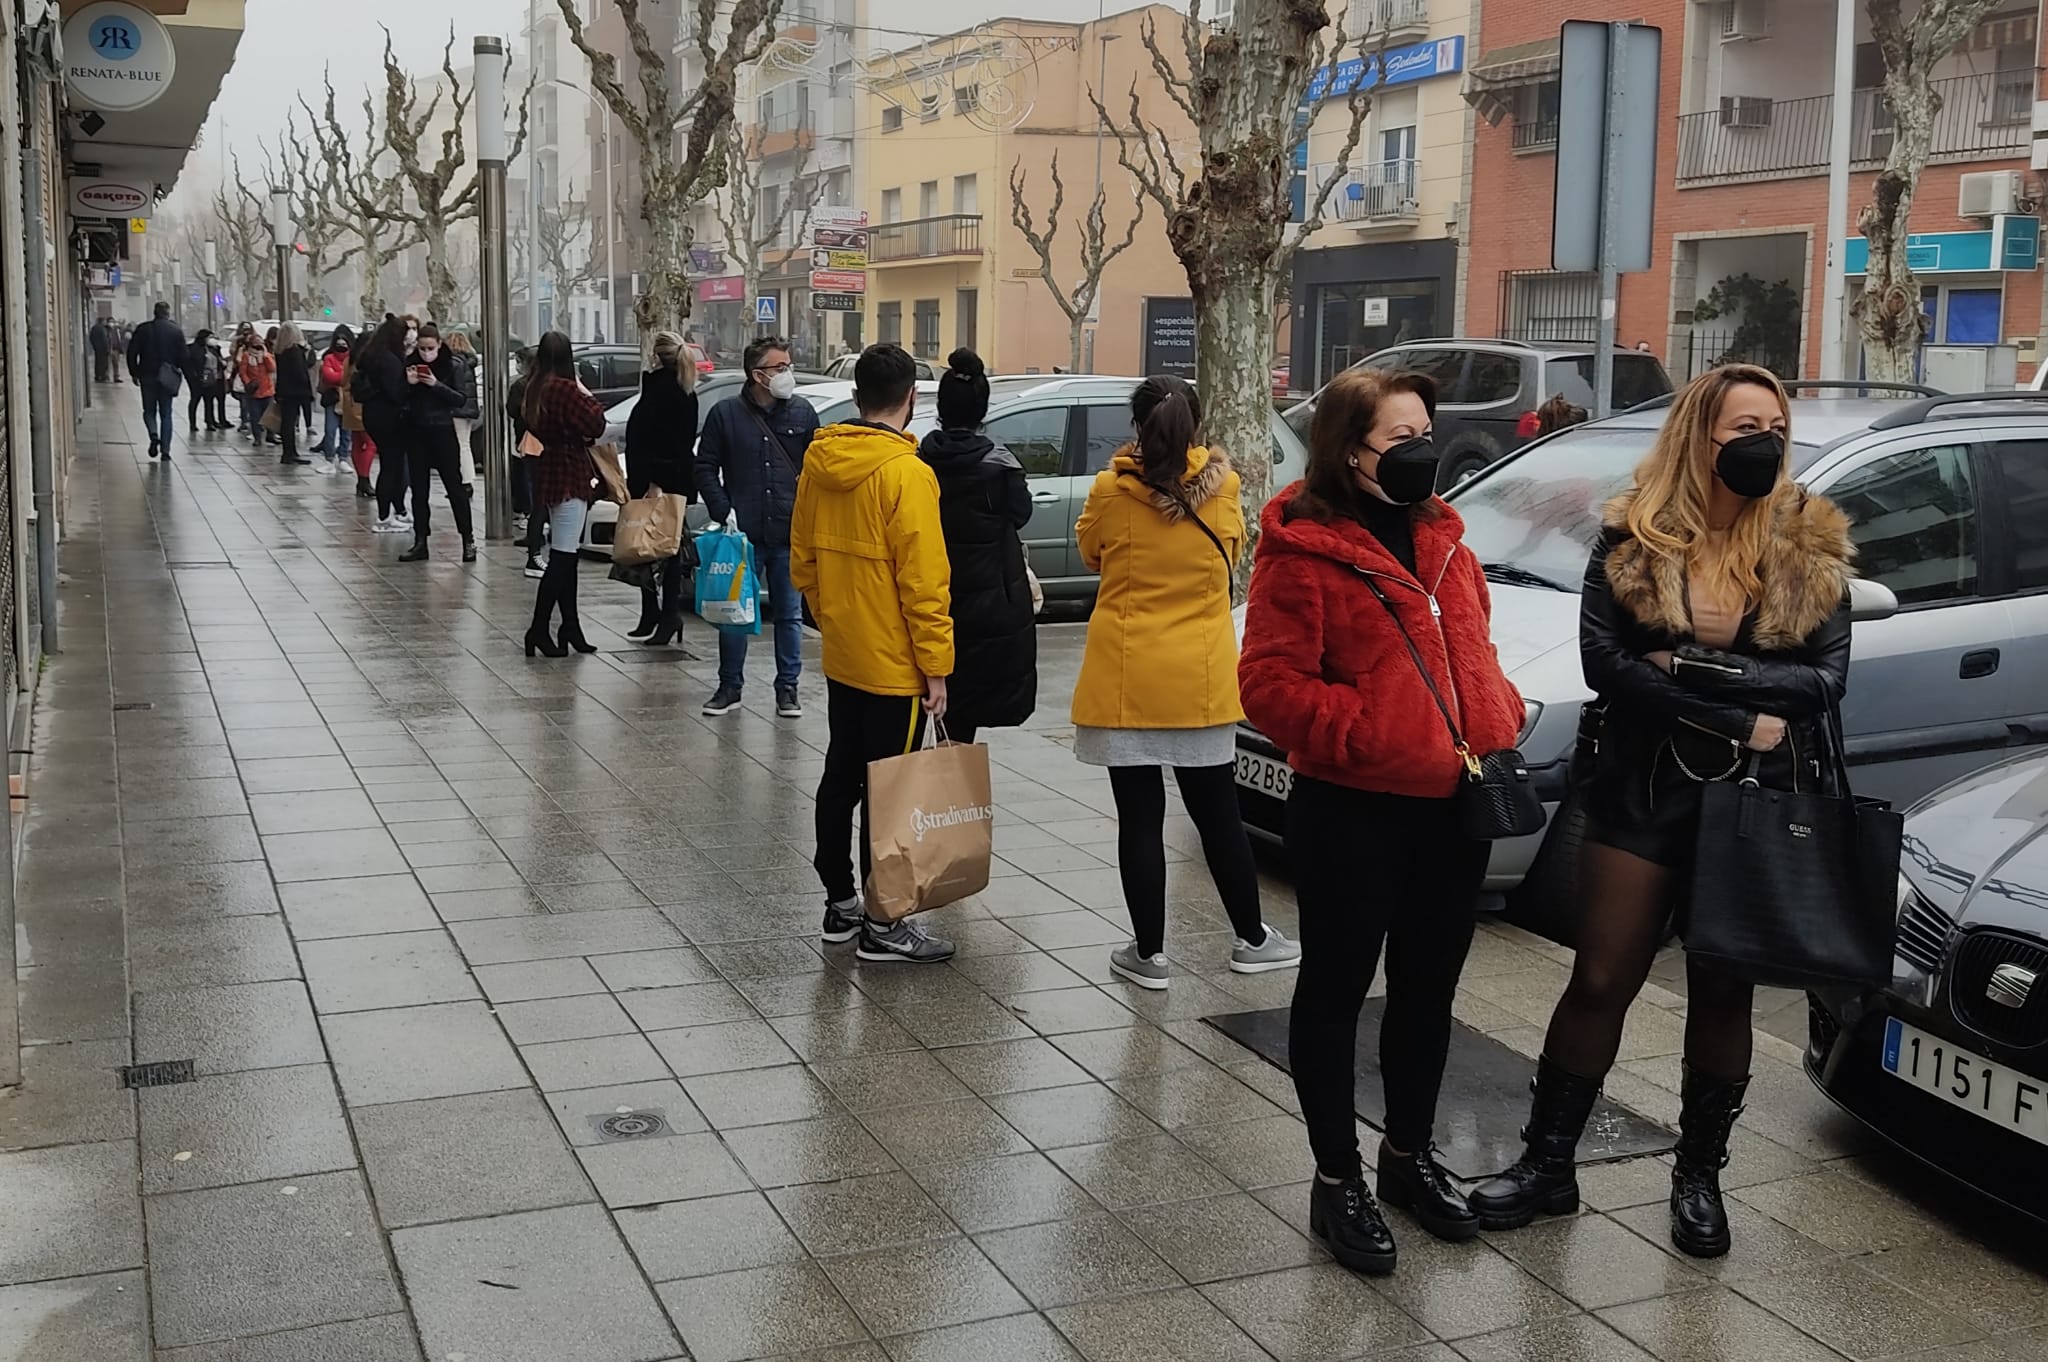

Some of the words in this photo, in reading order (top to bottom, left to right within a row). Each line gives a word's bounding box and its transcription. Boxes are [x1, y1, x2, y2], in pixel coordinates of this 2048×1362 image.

[71, 67, 162, 81] RENATA-BLUE
[1153, 338, 1191, 346] +servicios
[1911, 1037, 1993, 1111] 1151
[2013, 1081, 2048, 1124] F
